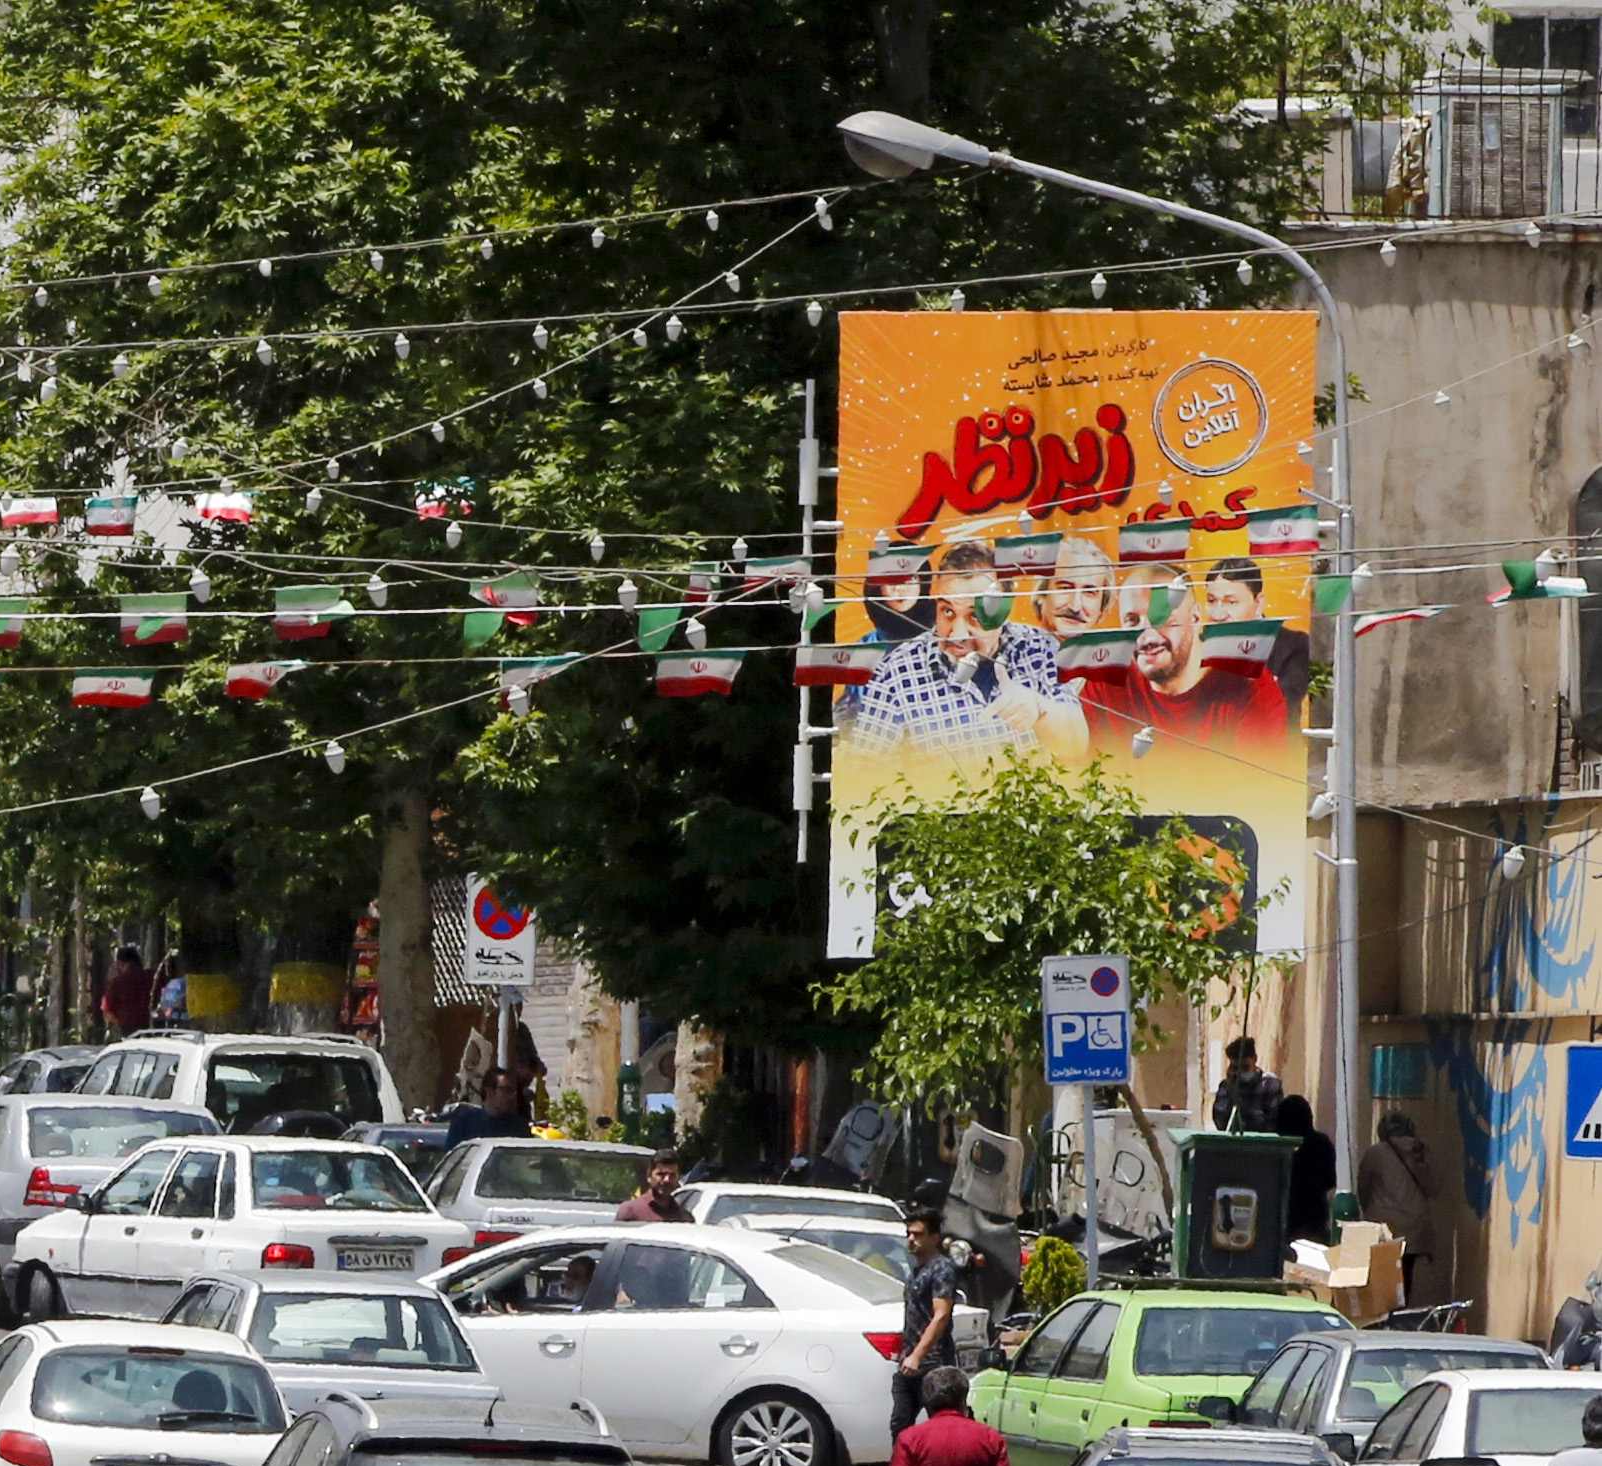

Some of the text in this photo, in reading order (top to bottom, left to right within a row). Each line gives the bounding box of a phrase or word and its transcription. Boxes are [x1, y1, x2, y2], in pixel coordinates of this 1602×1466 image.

[1008, 347, 1057, 370] صالحی
[1062, 348, 1100, 364] مجید
[1003, 372, 1053, 395] شایسته
[1056, 374, 1100, 388] محمد
[1178, 383, 1237, 422] اکران
[1184, 407, 1241, 449] آنلاین
[896, 403, 1135, 540] زیر نظر
[1052, 1014, 1085, 1058] P
